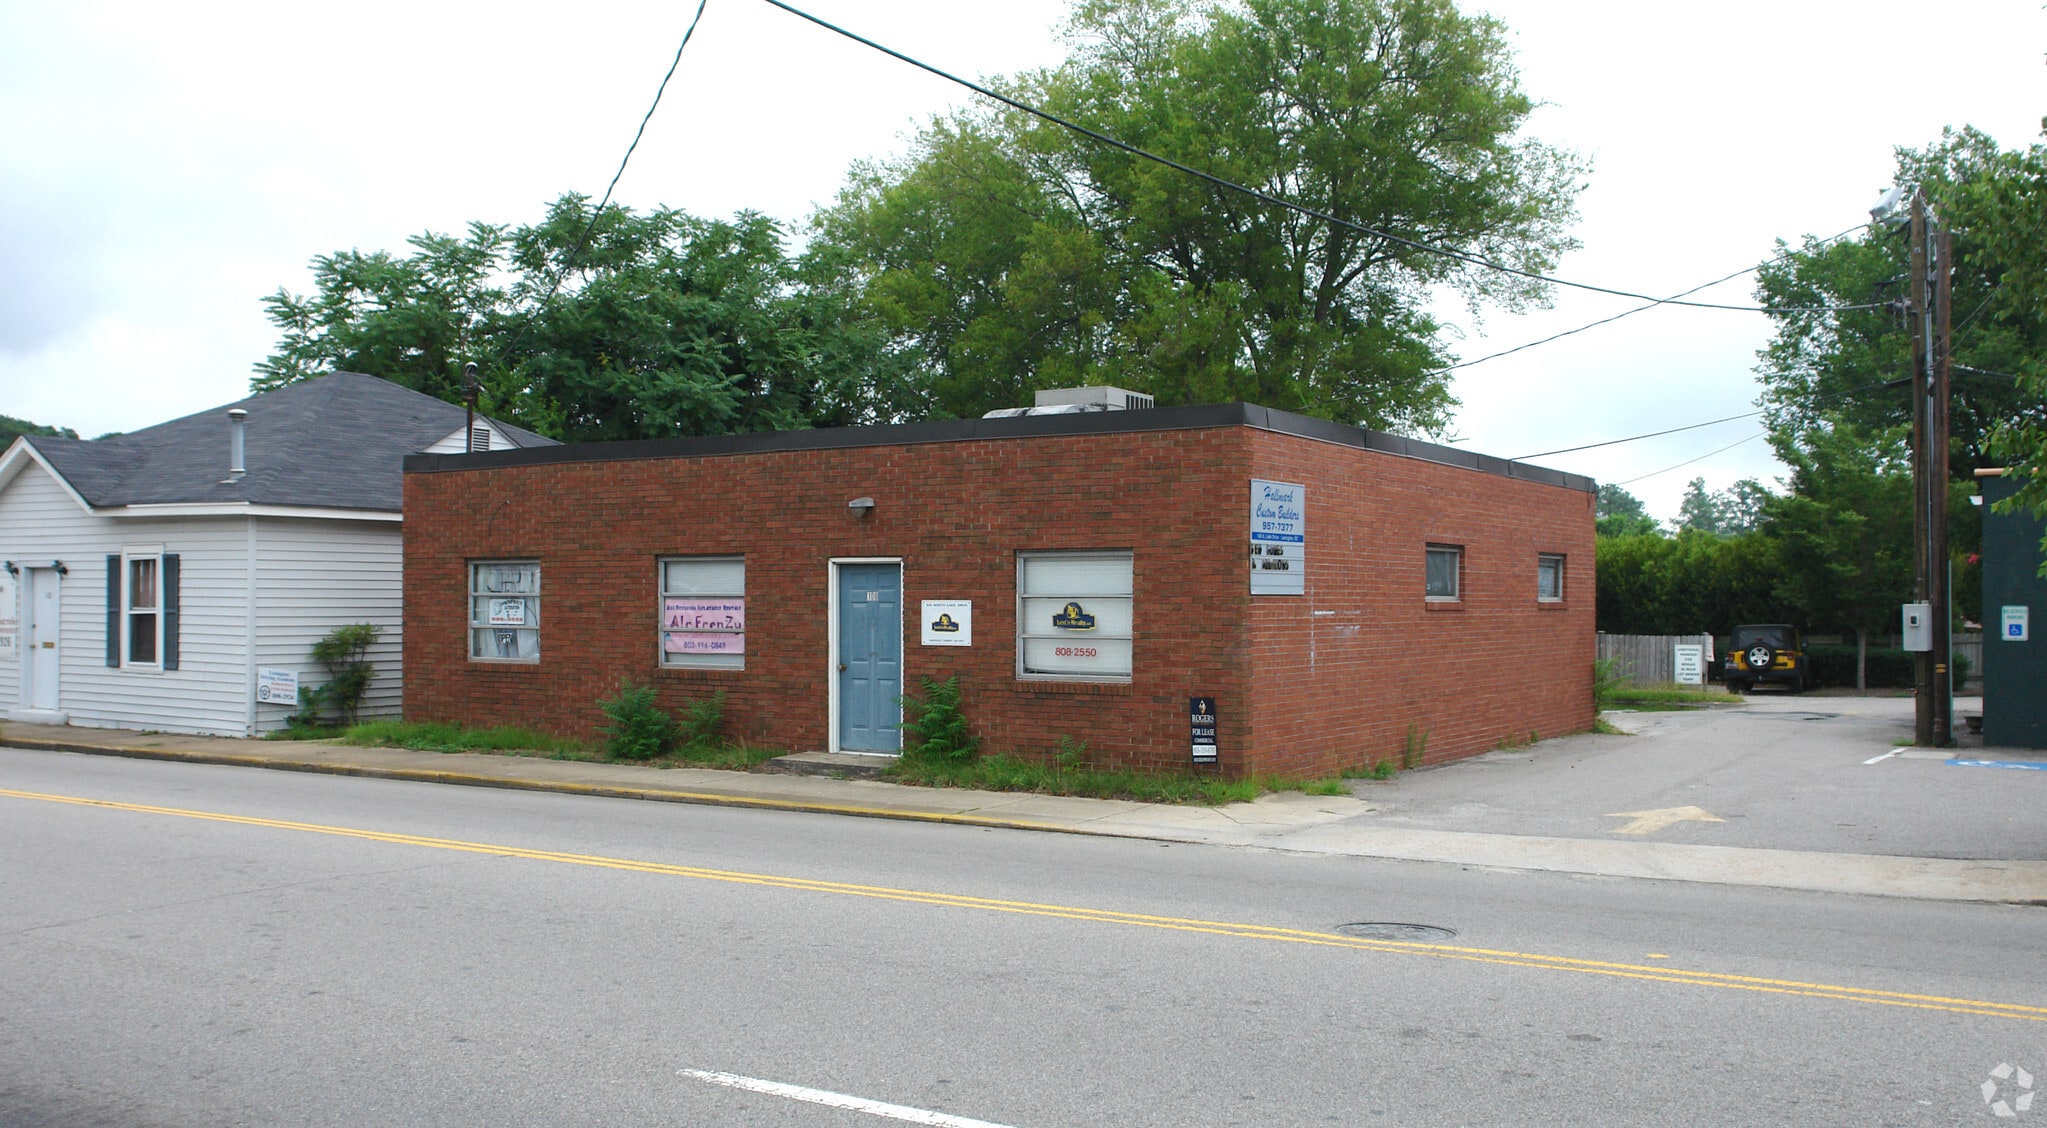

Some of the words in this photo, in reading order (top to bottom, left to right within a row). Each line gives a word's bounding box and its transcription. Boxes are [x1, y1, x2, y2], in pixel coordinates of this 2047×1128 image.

[1263, 486, 1294, 503] Hallmark
[1256, 503, 1276, 518] Custom
[1278, 505, 1299, 520] Builders
[1262, 521, 1294, 531] 957-7377
[1191, 714, 1216, 723] ROGERS
[1192, 728, 1201, 736] FOR
[1201, 728, 1216, 736] LEASE
